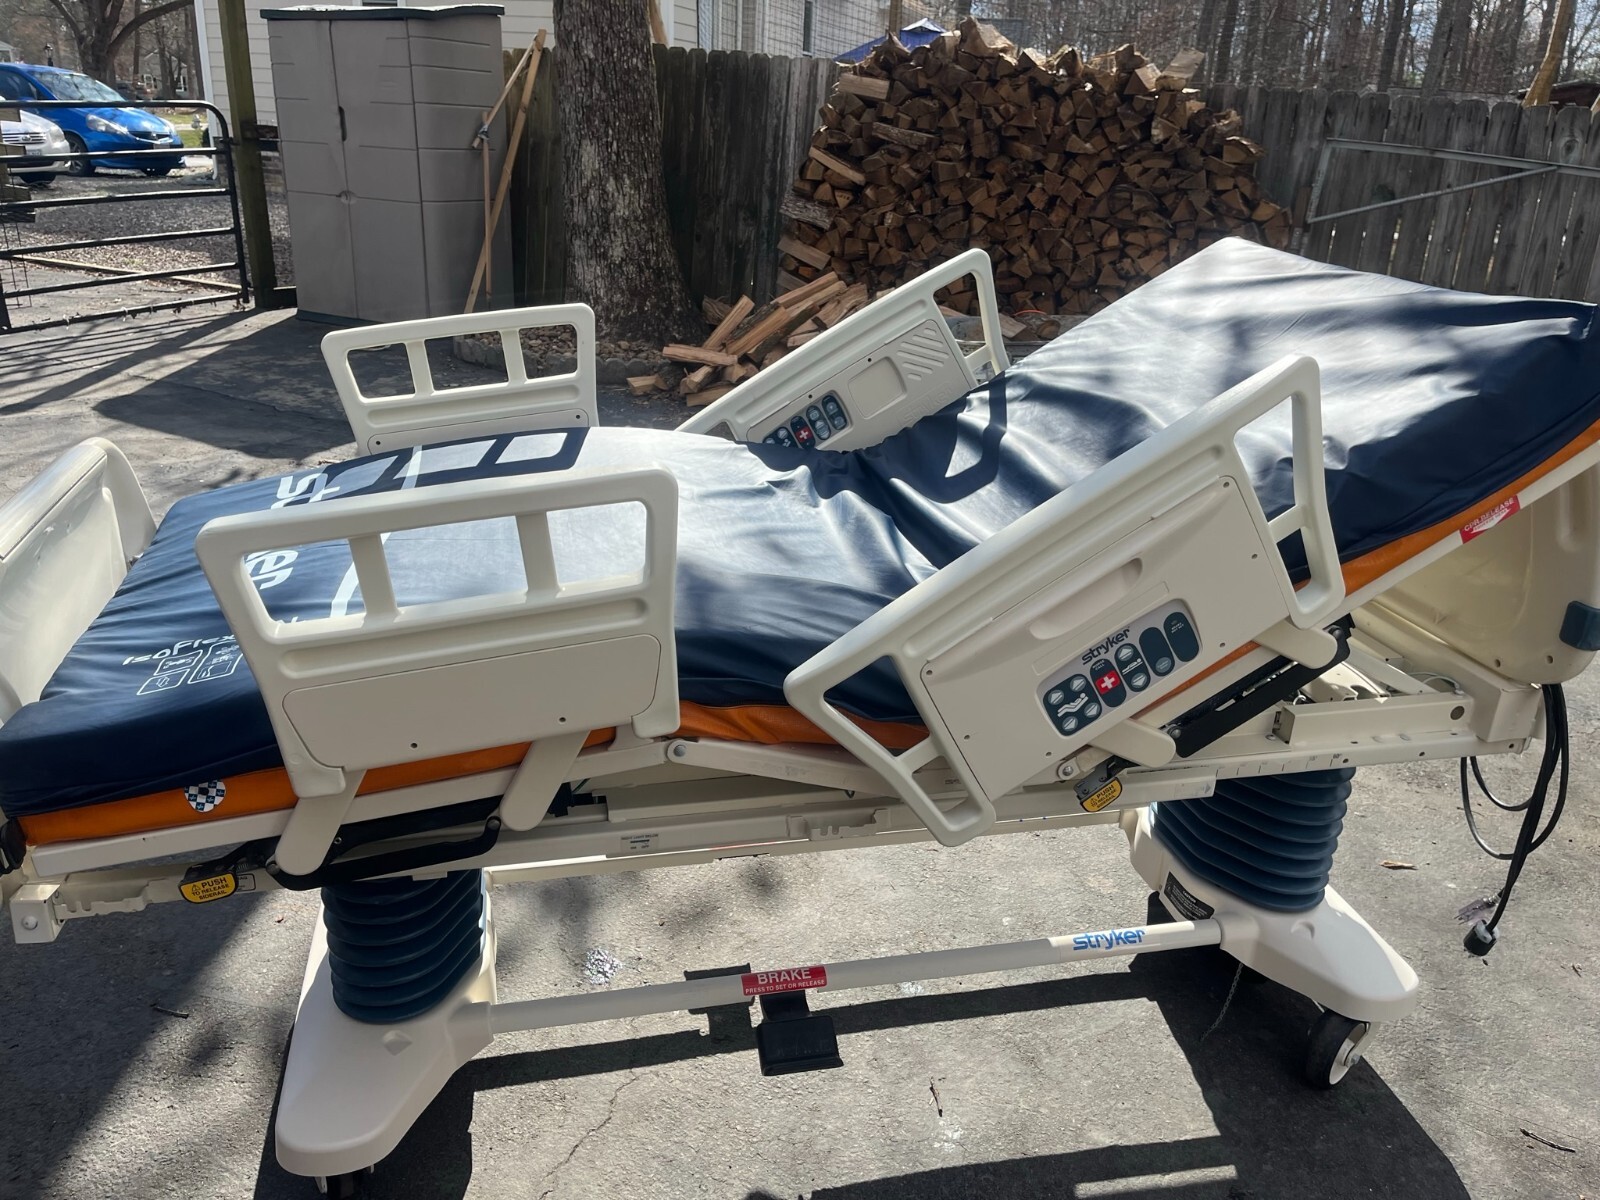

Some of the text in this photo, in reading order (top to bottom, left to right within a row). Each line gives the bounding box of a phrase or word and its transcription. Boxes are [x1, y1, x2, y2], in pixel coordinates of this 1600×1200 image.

[1480, 497, 1514, 520] RELEASE
[1082, 628, 1130, 665] stryker
[1096, 784, 1115, 799] PUSH
[201, 877, 227, 889] PUSH
[201, 883, 231, 895] RELEASE
[757, 968, 812, 985] BRAKE
[798, 979, 825, 987] RELEASE
